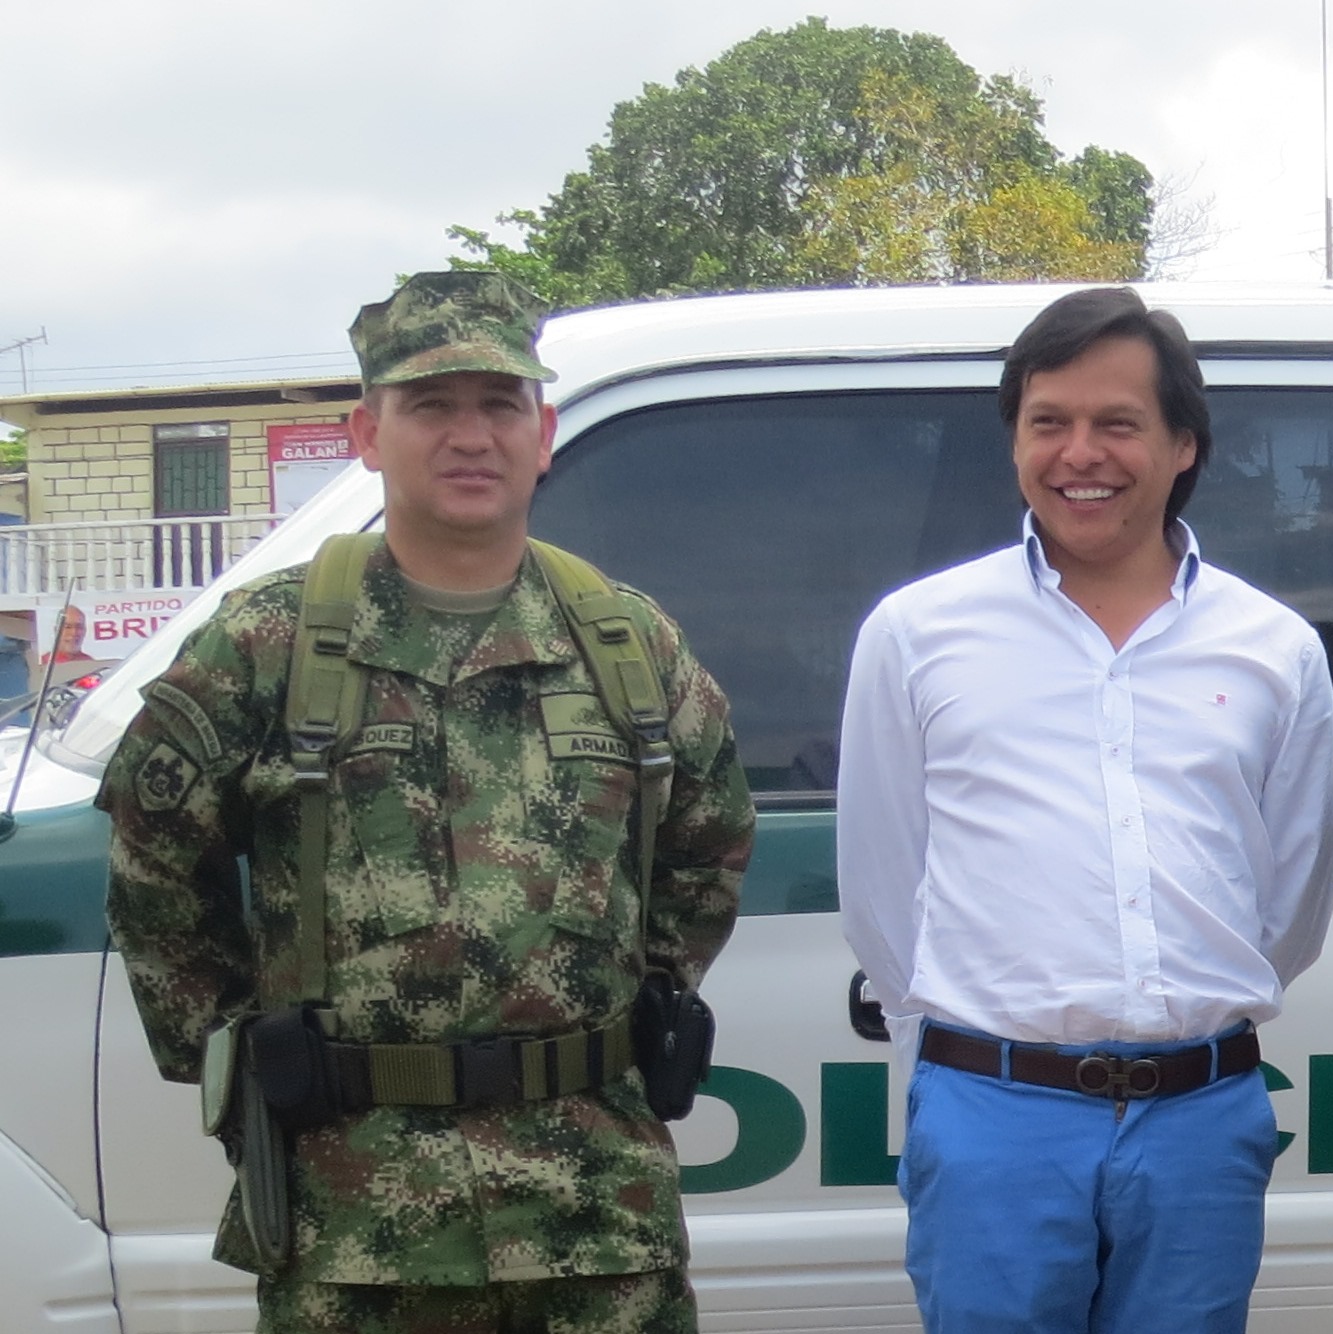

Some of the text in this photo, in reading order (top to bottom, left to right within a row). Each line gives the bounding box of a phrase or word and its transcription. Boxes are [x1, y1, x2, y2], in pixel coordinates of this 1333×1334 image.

[281, 446, 337, 459] GALAN
[94, 598, 183, 616] PARTIDO
[362, 728, 413, 744] QUEZ
[570, 738, 630, 758] ARMAD
